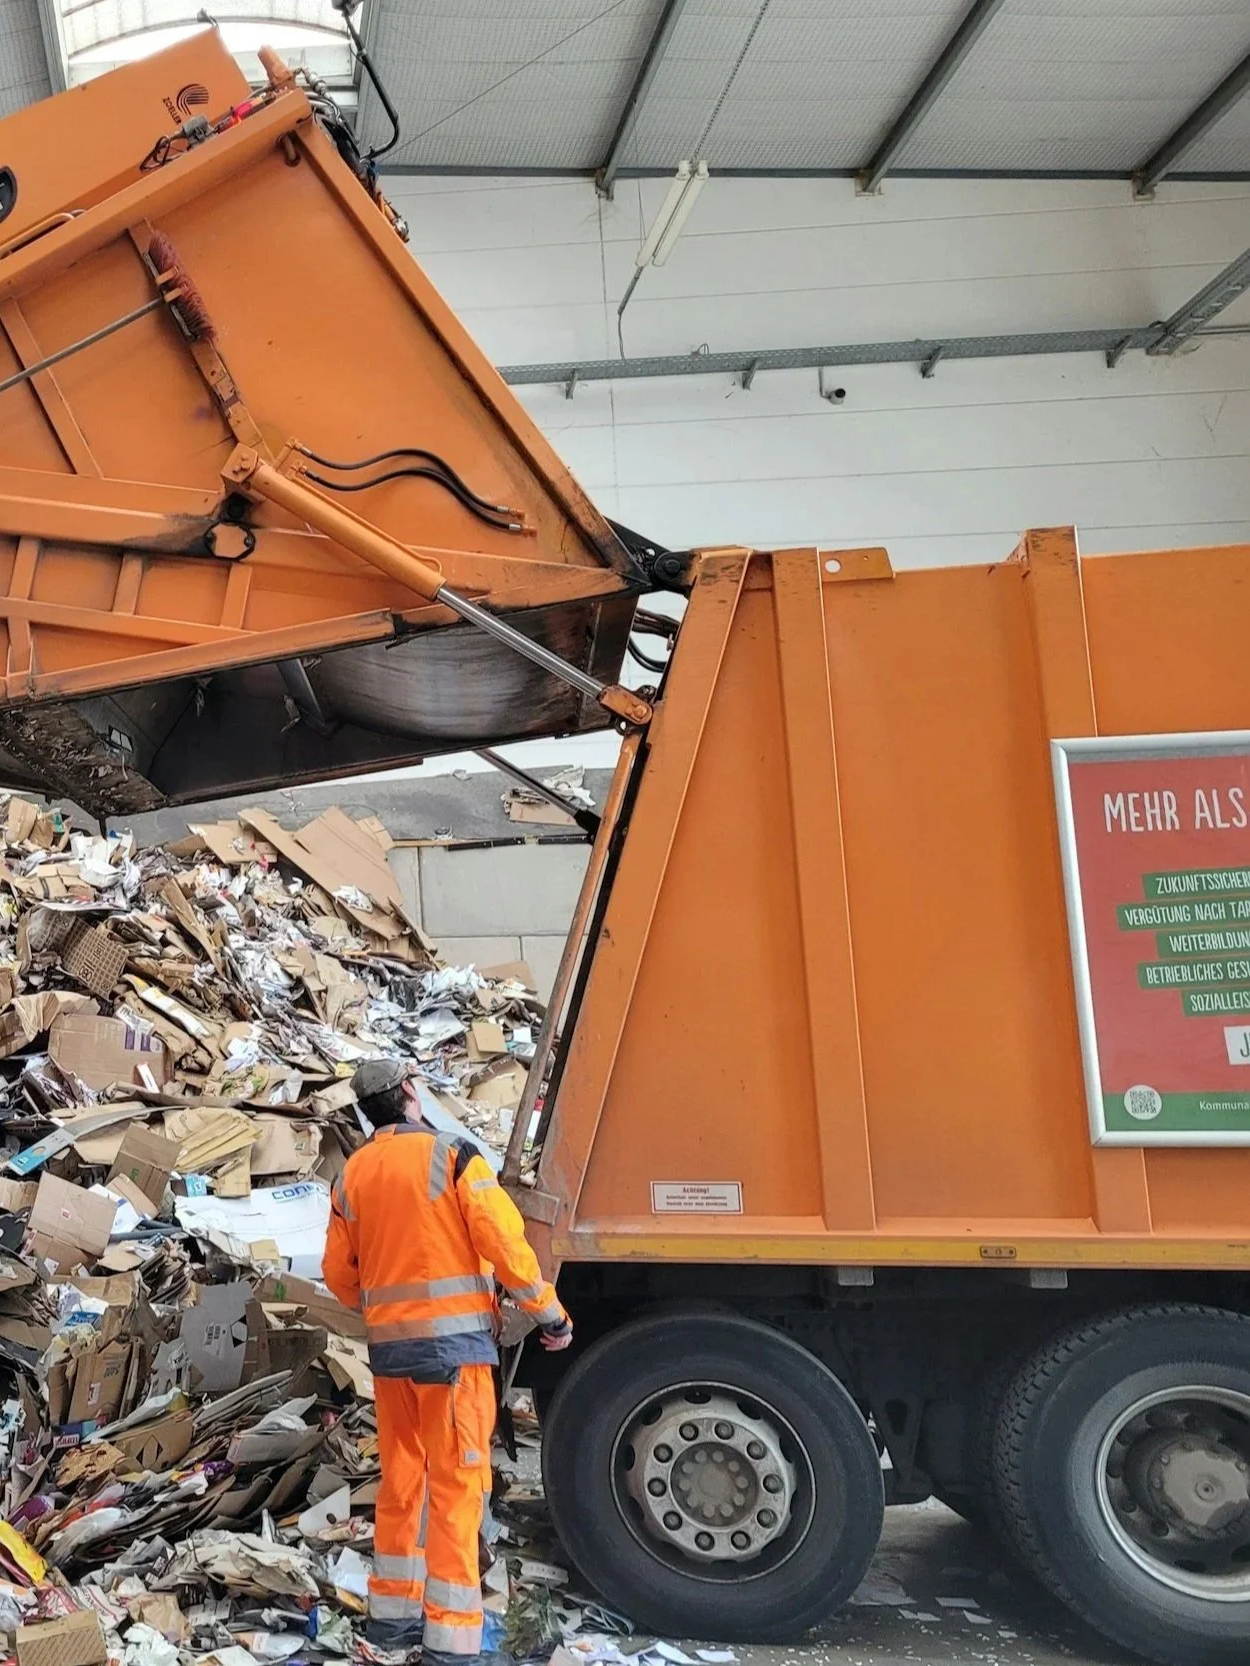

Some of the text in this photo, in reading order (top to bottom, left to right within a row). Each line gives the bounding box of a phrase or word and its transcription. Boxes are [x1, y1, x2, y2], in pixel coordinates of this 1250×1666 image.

[162, 96, 182, 126] ZOELLER
[1103, 787, 1249, 833] MEHR ALS
[1155, 870, 1250, 895] ZUKUNFTSSICHER
[1124, 904, 1192, 926] VERGÜTUNG
[1194, 902, 1226, 921] NACH
[1146, 962, 1224, 985] BETRIEBLICHES
[1190, 991, 1250, 1013] SOZIALLEIS
[1239, 1031, 1250, 1058] J
[682, 1186, 711, 1194] Achtung!
